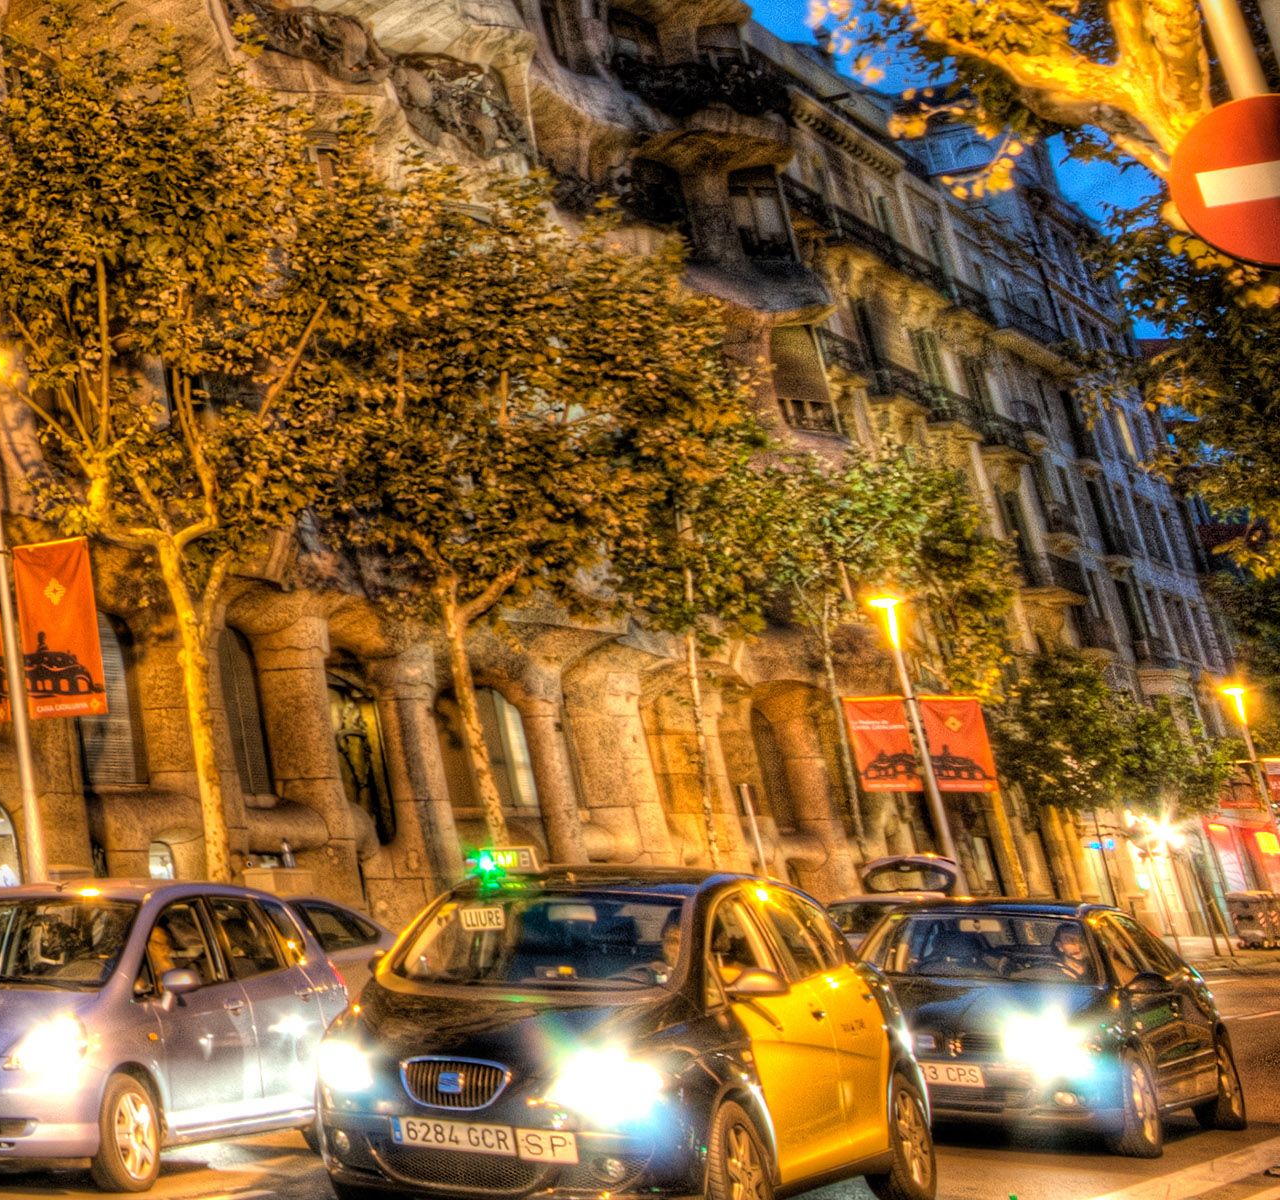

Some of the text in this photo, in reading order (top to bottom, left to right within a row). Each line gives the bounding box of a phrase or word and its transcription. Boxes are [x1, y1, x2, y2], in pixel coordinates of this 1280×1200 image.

[463, 909, 502, 928] LLIURE
[945, 1066, 980, 1084] CPS
[405, 1120, 568, 1158] 6284 GCR SP
